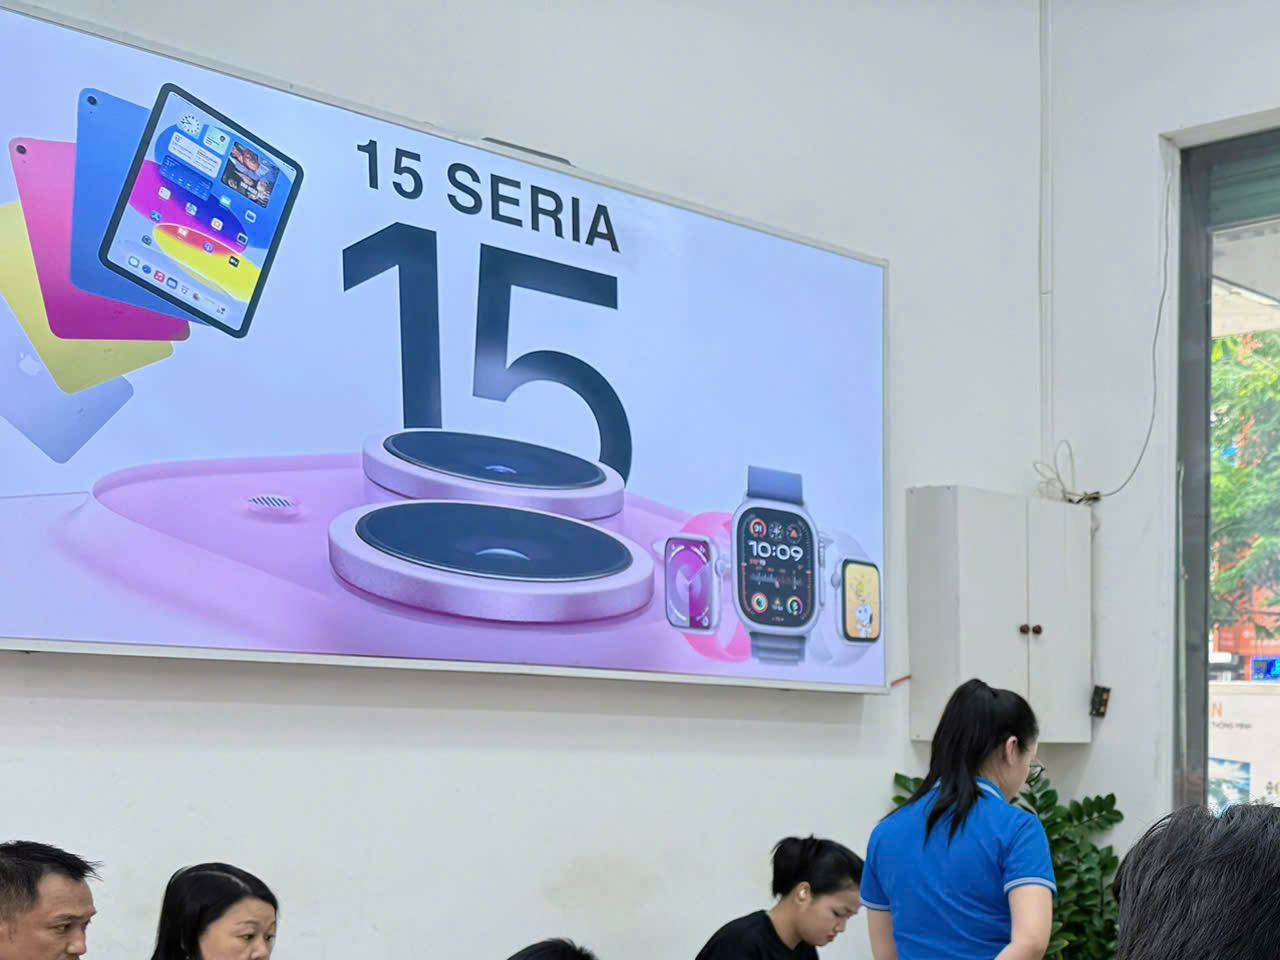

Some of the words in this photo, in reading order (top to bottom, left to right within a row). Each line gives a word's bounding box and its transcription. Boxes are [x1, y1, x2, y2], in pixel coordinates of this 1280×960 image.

[357, 139, 425, 201] 15
[447, 162, 621, 254] SERIA
[342, 222, 633, 487] 15
[748, 540, 804, 562] 10:09
